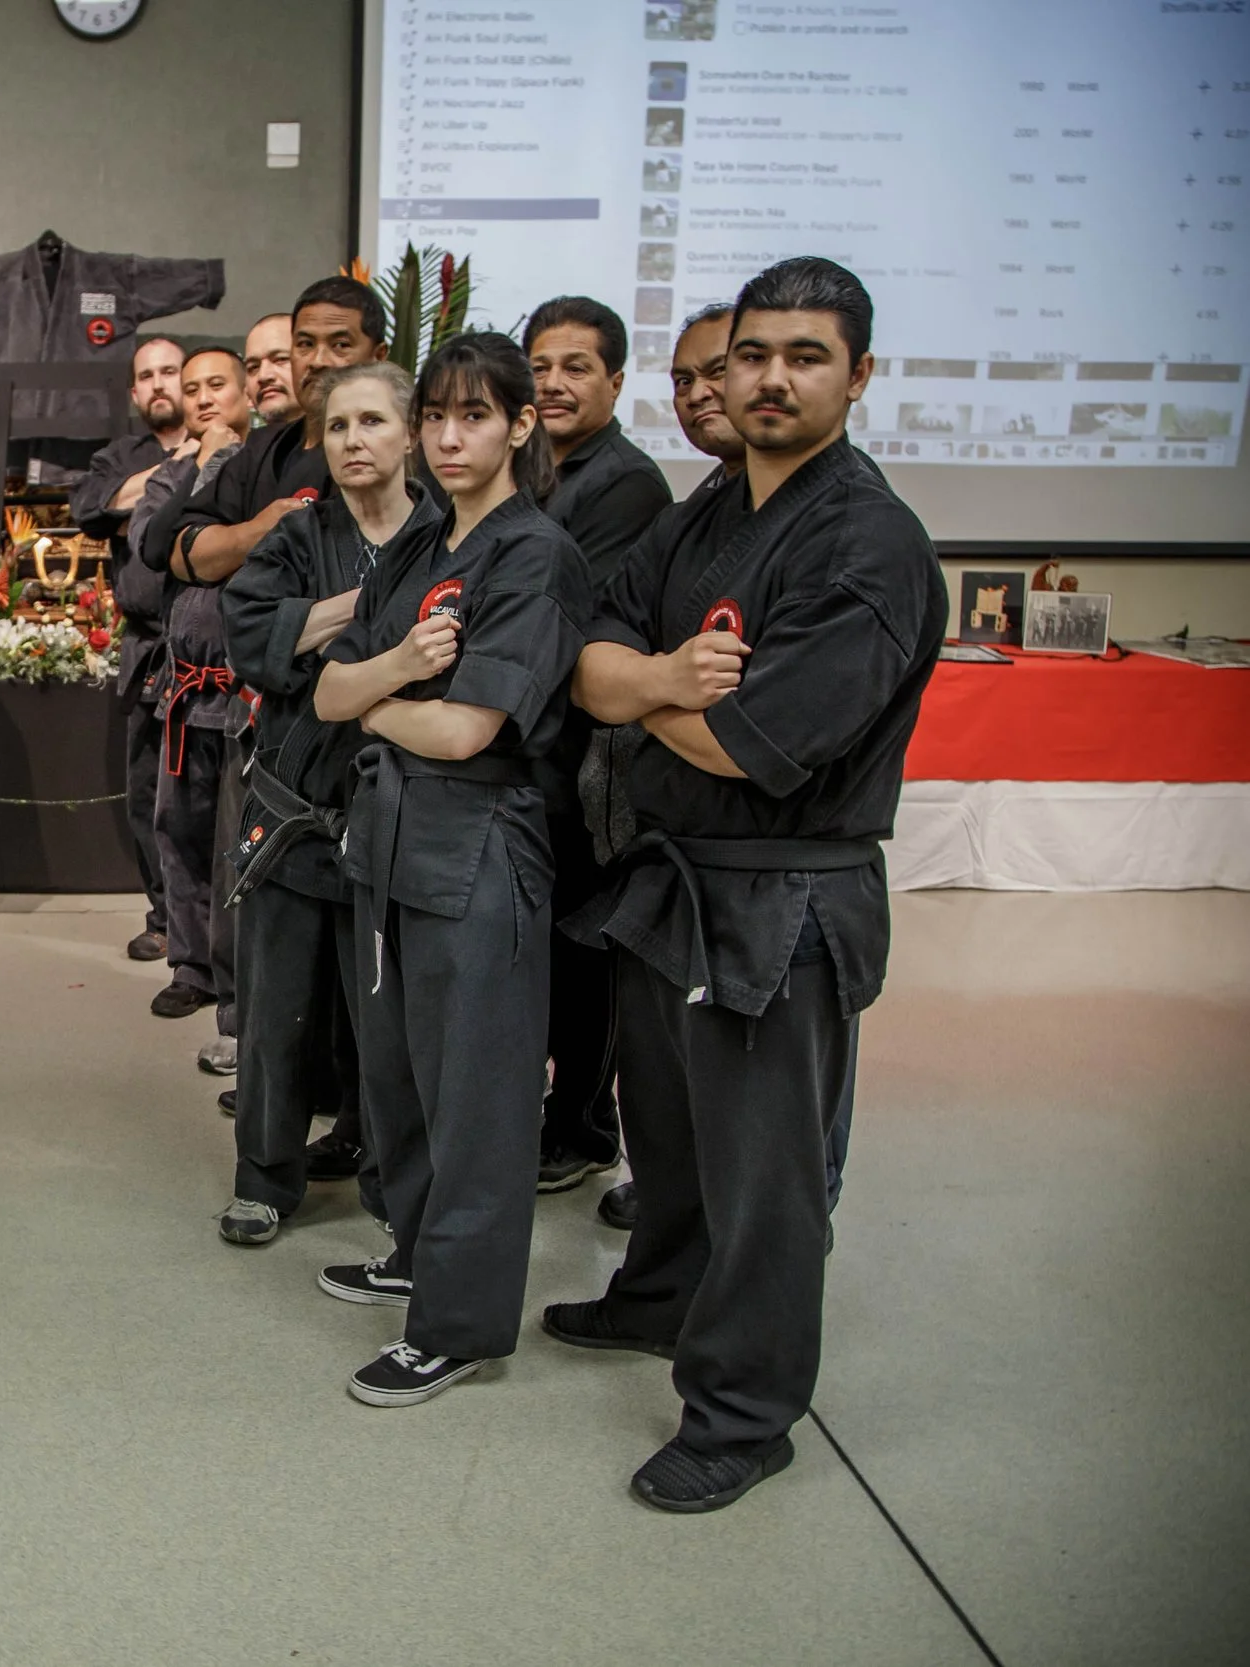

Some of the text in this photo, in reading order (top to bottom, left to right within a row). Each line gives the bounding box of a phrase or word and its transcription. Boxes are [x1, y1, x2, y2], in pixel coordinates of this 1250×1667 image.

[79, 10, 87, 22] 7
[93, 14, 102, 26] 6
[109, 10, 117, 22] 5
[430, 605, 459, 617] VACAVILL
